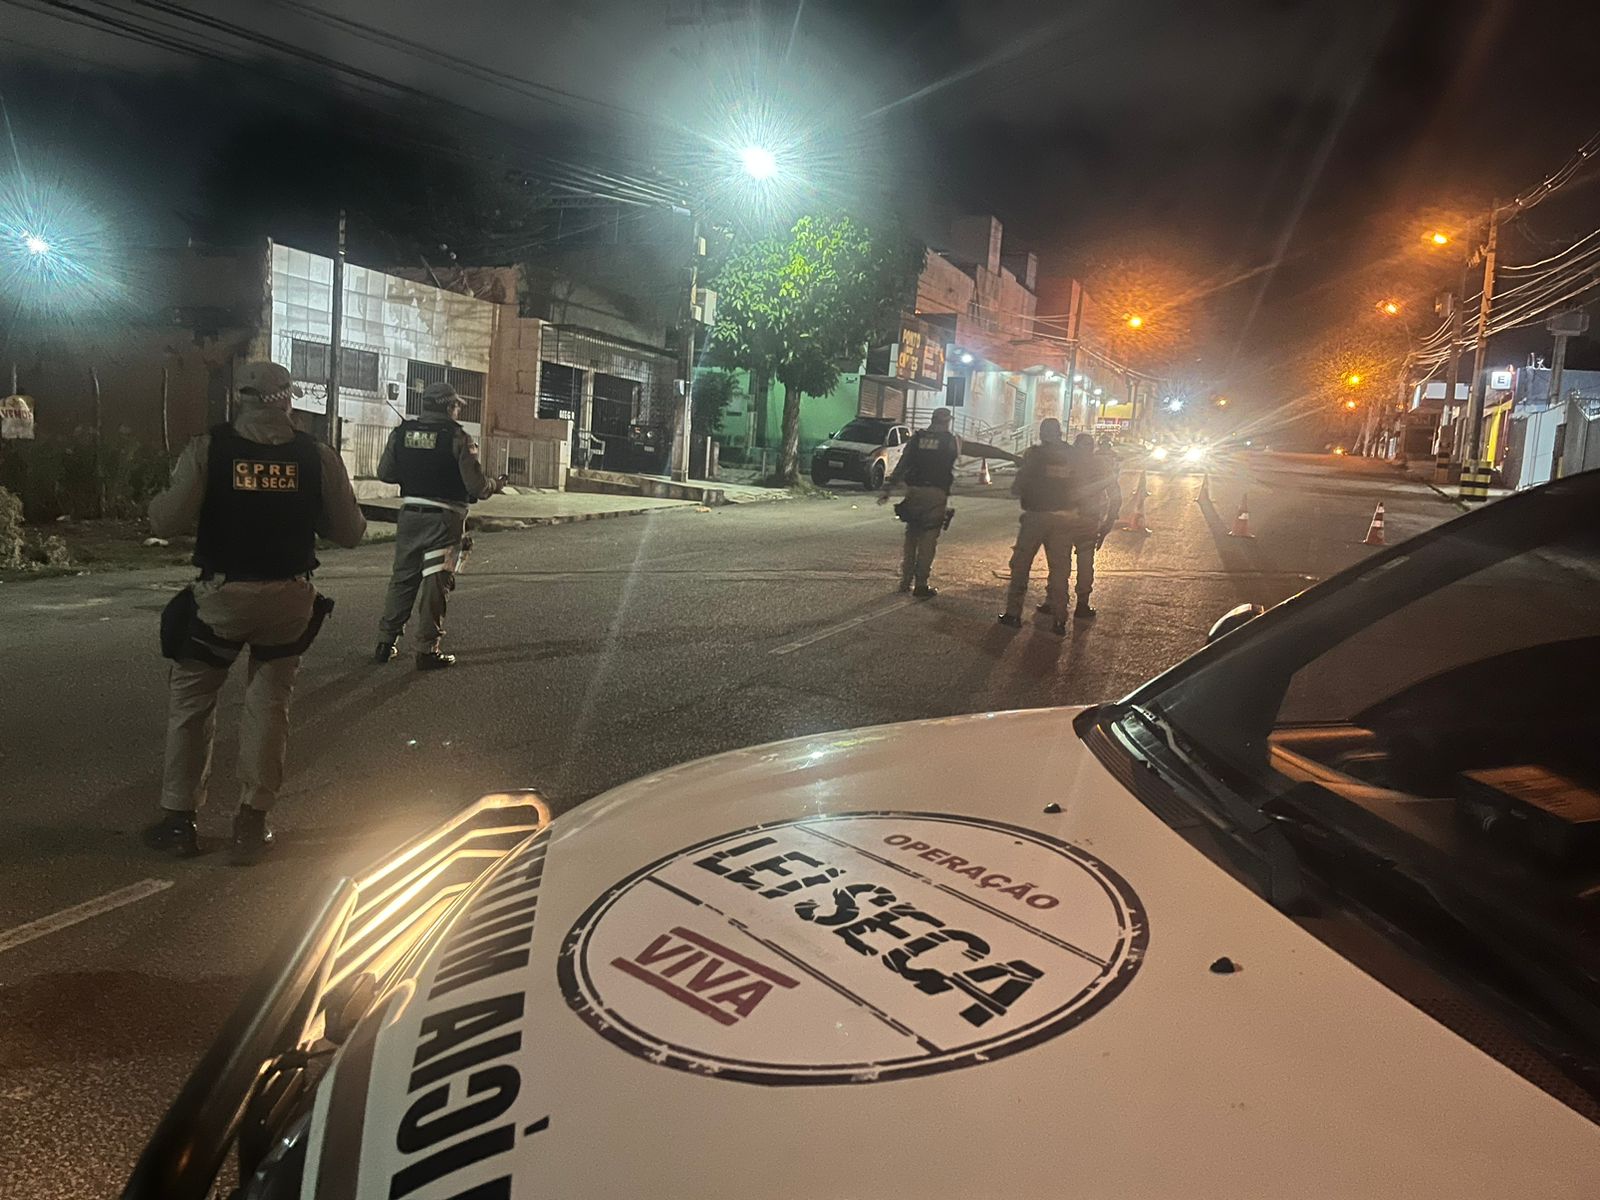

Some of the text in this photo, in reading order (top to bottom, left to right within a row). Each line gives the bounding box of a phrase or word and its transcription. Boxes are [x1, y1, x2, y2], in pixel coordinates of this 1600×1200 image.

[236, 462, 296, 476] CPRE
[236, 476, 296, 489] LEI SECA
[883, 834, 1060, 910] OPERAÇÃO
[634, 933, 774, 1019] VIVA
